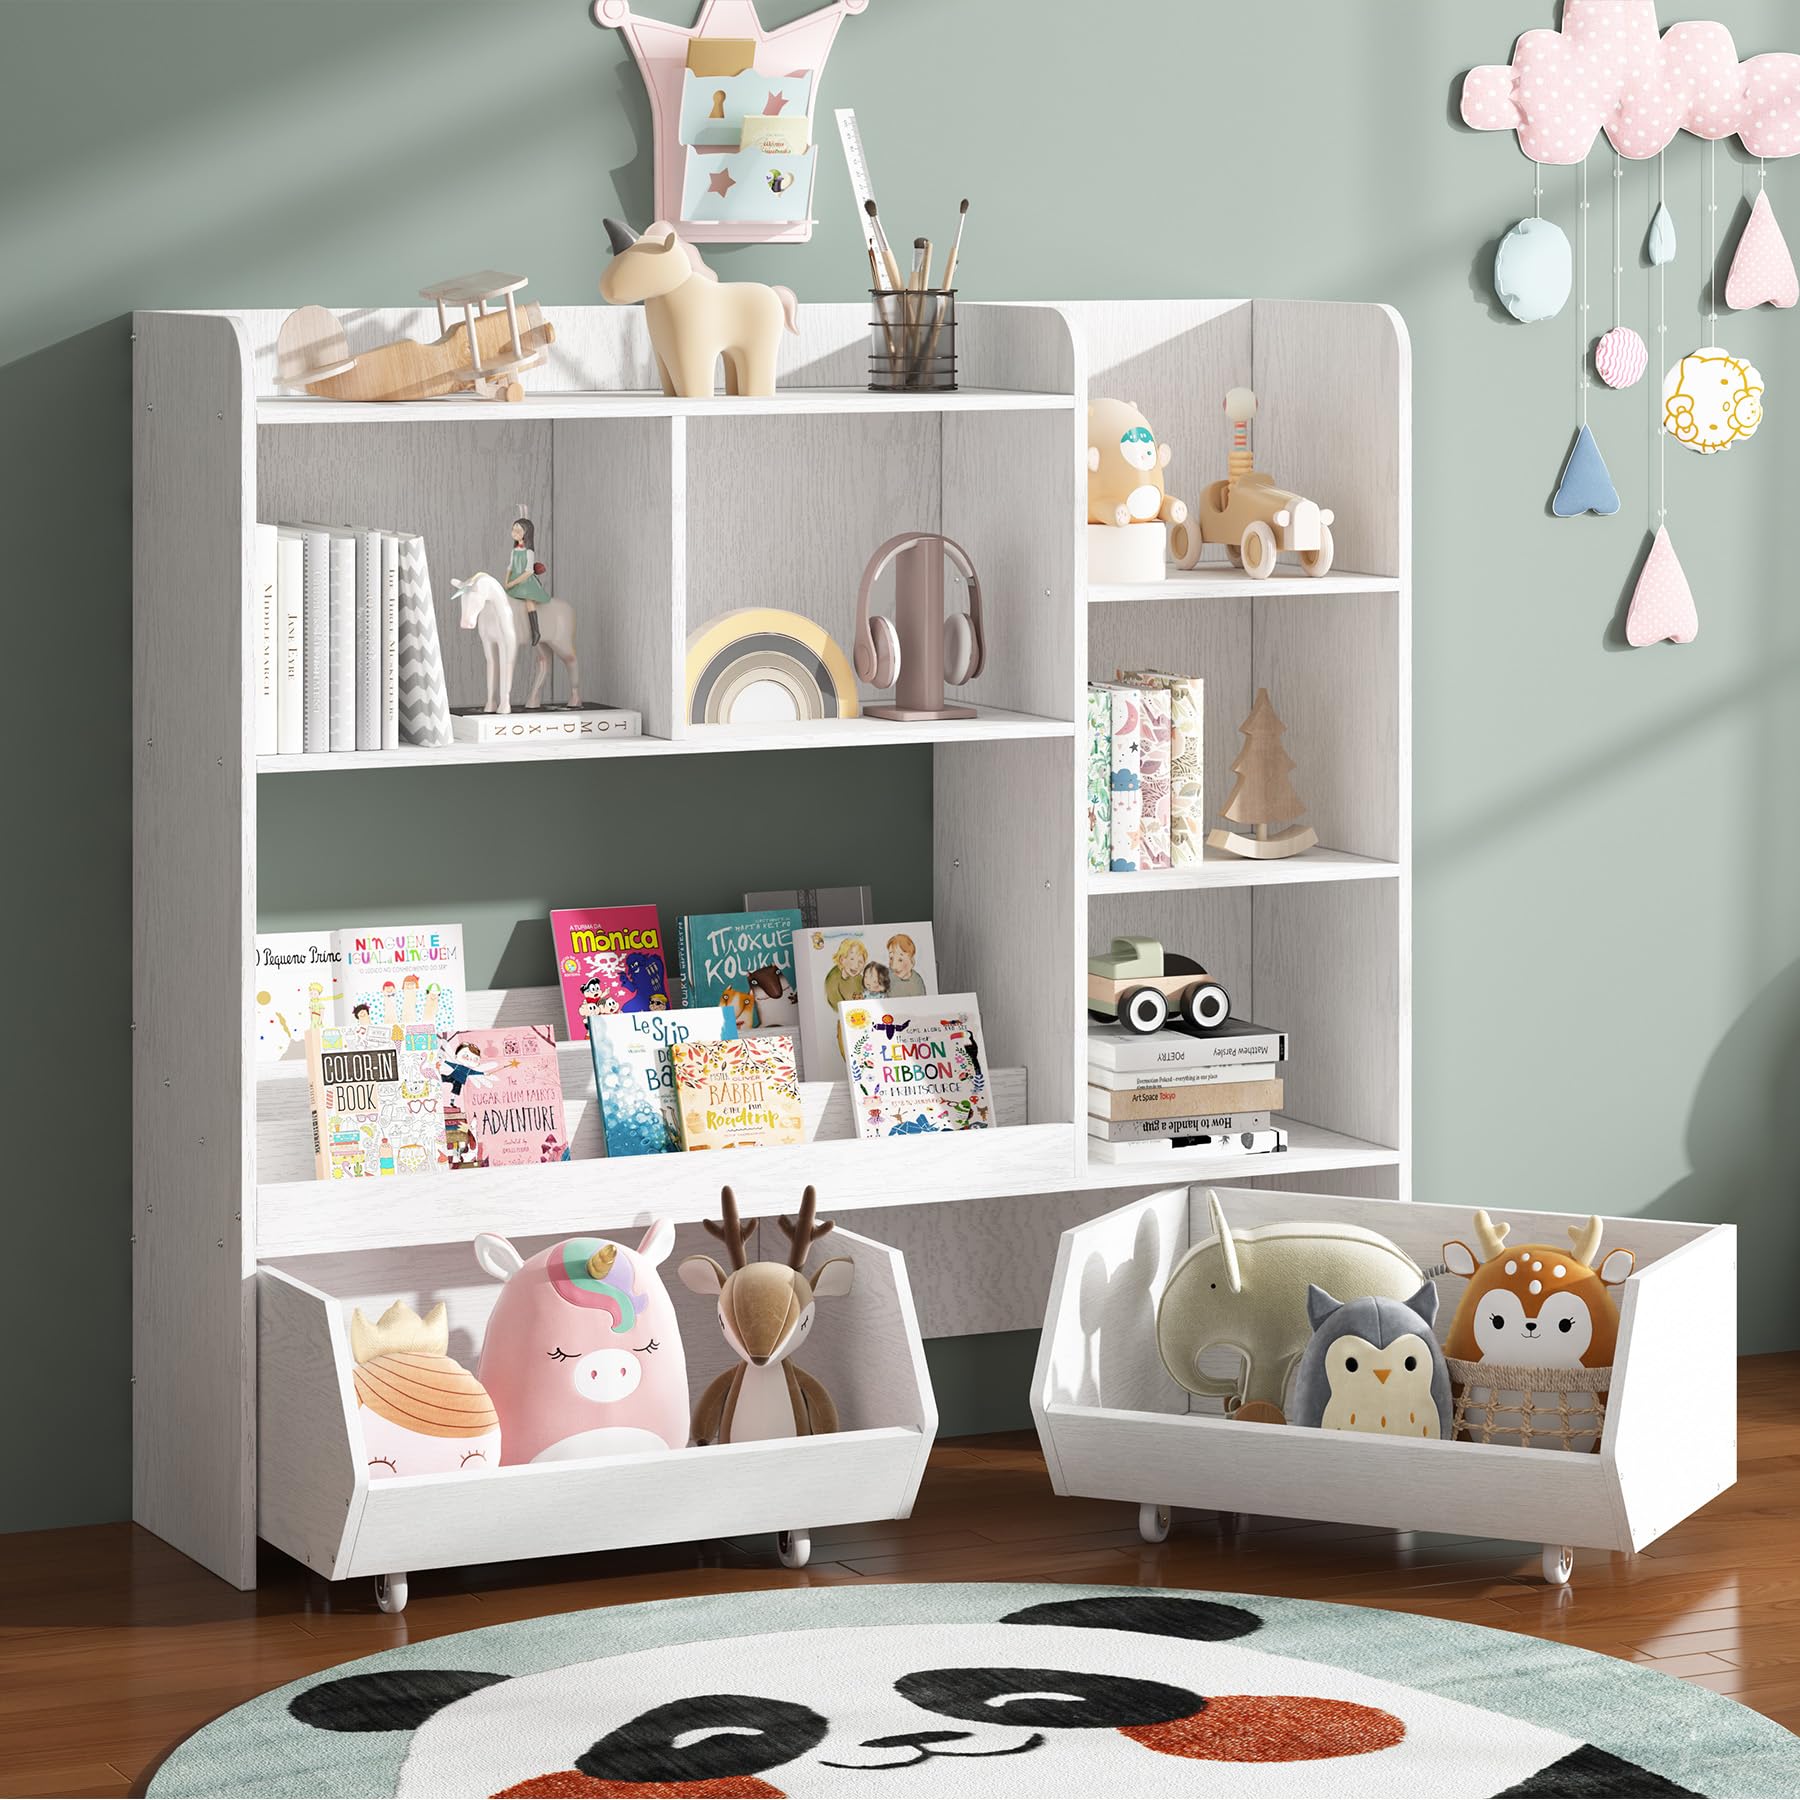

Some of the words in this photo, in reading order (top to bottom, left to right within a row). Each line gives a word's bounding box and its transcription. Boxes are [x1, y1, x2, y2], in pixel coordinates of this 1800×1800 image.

[287, 613, 298, 641] JANE
[287, 648, 298, 681] EYRE
[263, 947, 307, 970] Pequeno
[632, 1014, 650, 1034] Le
[880, 1041, 946, 1061] LEMON
[1156, 1051, 1185, 1062] POETRY
[1213, 1047, 1237, 1057] Parsley
[1238, 1045, 1269, 1055] Matthew
[882, 1062, 953, 1083] RIBBON
[336, 1084, 377, 1112] BOOK
[472, 1091, 500, 1106] SUGAR
[709, 1081, 765, 1106] RABBIT
[1132, 1094, 1142, 1102] Art
[1142, 1093, 1158, 1102] Space
[1159, 1092, 1176, 1101] Tokyo
[482, 1105, 558, 1135] ADVENTURE
[707, 1107, 779, 1130] Roadtrip
[1162, 1122, 1168, 1131] a
[1168, 1119, 1200, 1133] handle
[1201, 1118, 1210, 1128] to
[1211, 1117, 1232, 1128] How
